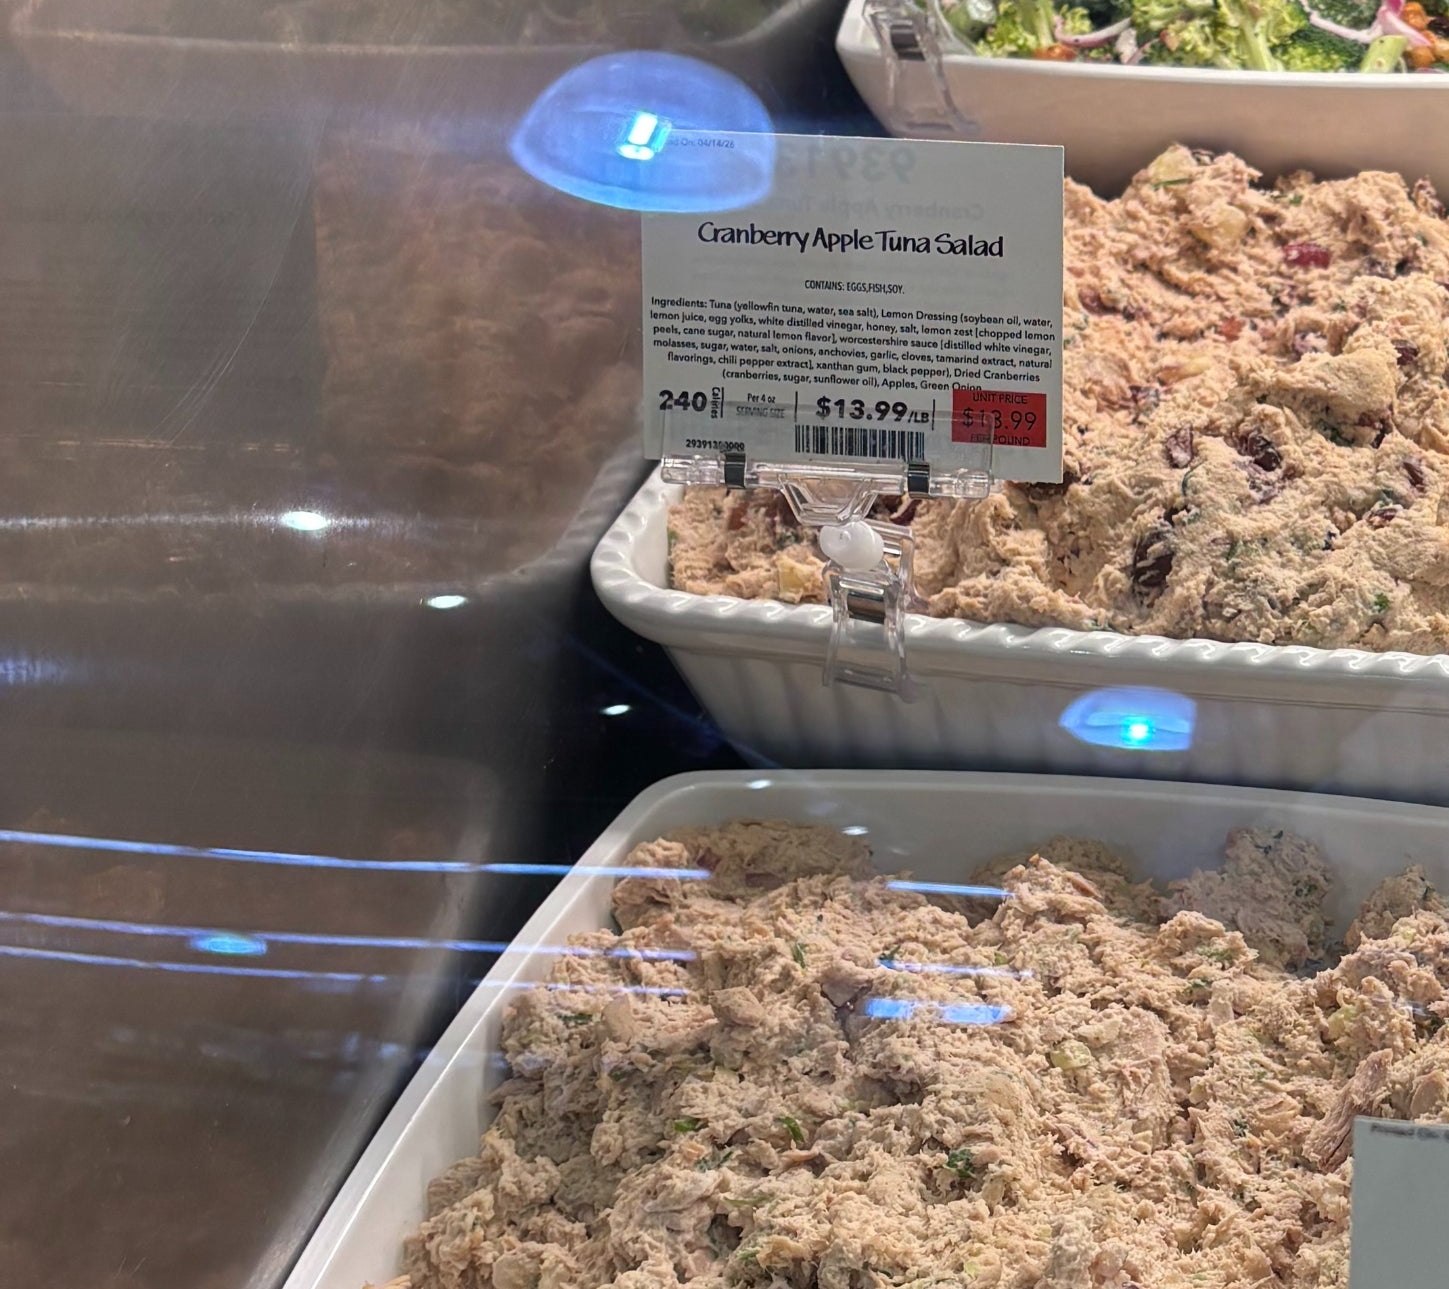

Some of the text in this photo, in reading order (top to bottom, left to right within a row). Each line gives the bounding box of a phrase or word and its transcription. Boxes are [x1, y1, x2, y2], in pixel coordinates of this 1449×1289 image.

[698, 222, 1004, 258] Cranberry Apple Tuna Salad
[804, 279, 904, 294] CONTAINS: EGGS,FISH,SOY.
[651, 296, 1052, 328] Ingredients: Tuna (yellowfin tuna, water, sea salt), Lemon Dressing (soybean oil, water,
[659, 390, 706, 412] 240
[747, 392, 775, 404] Per 4 oz
[972, 393, 1028, 405] UNIT PRICE
[816, 396, 930, 424] $13.99/LB
